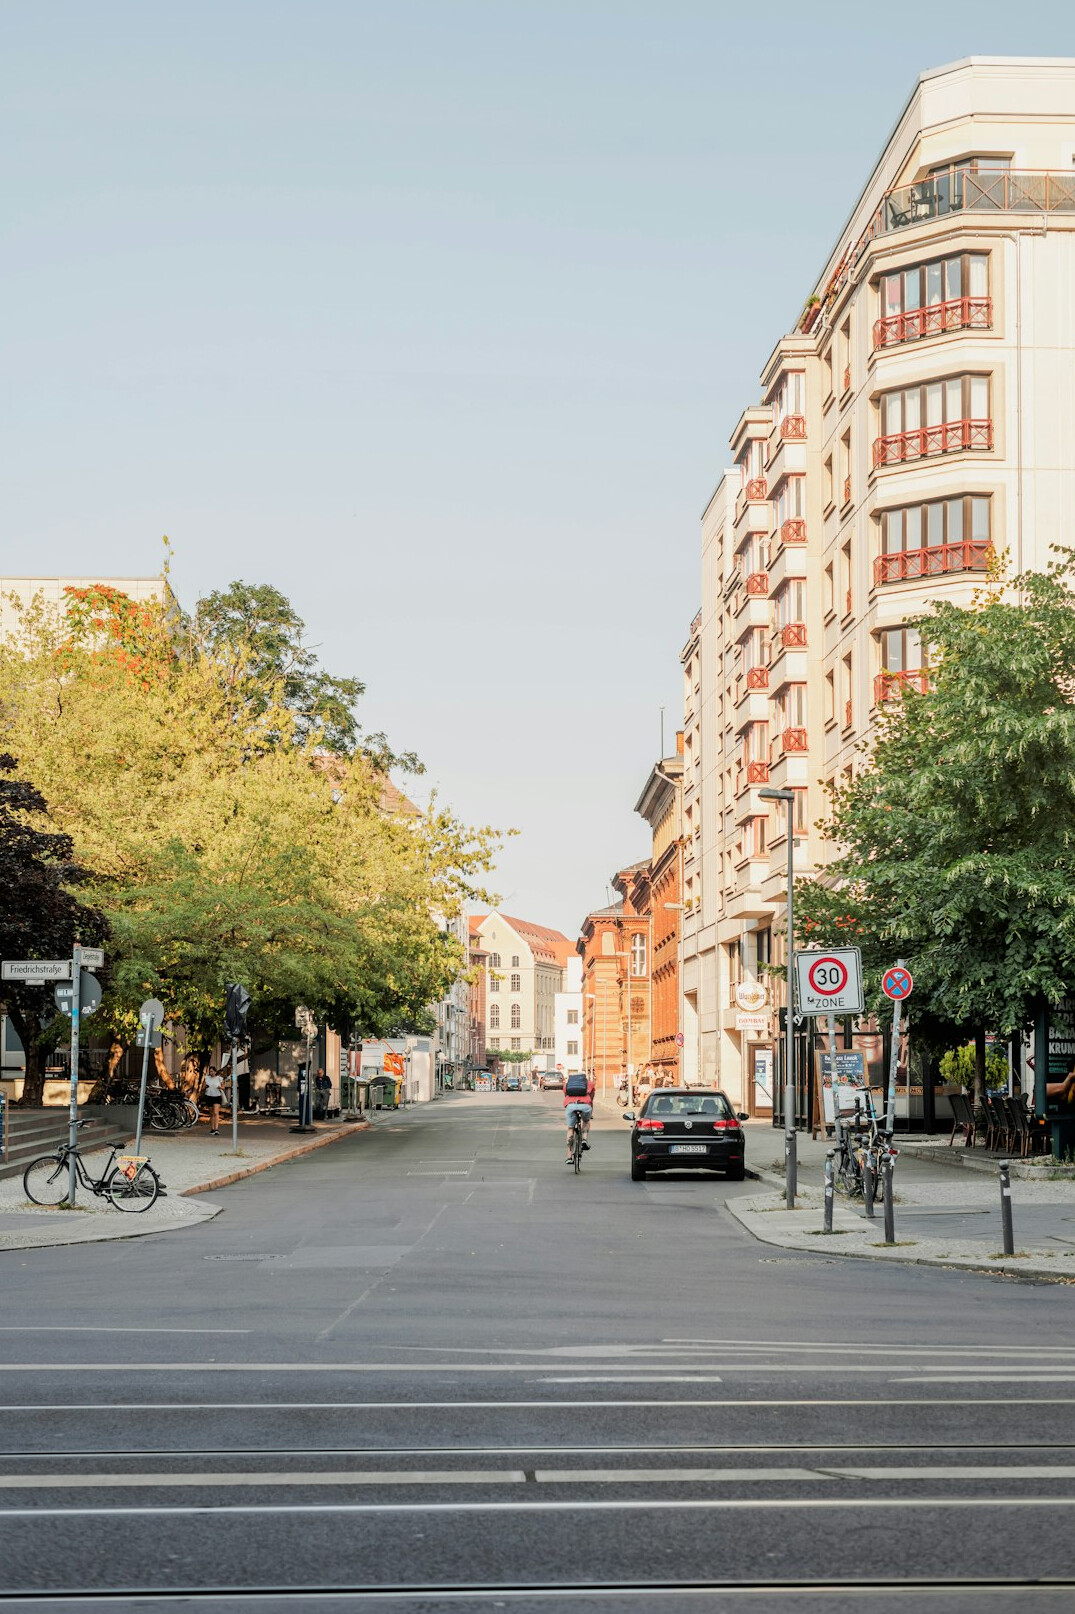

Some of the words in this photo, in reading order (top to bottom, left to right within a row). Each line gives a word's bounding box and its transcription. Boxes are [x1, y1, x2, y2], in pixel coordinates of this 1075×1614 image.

[10, 964, 62, 975] Friedrichstraße
[817, 967, 839, 985] 30
[815, 997, 845, 1008] ZONE
